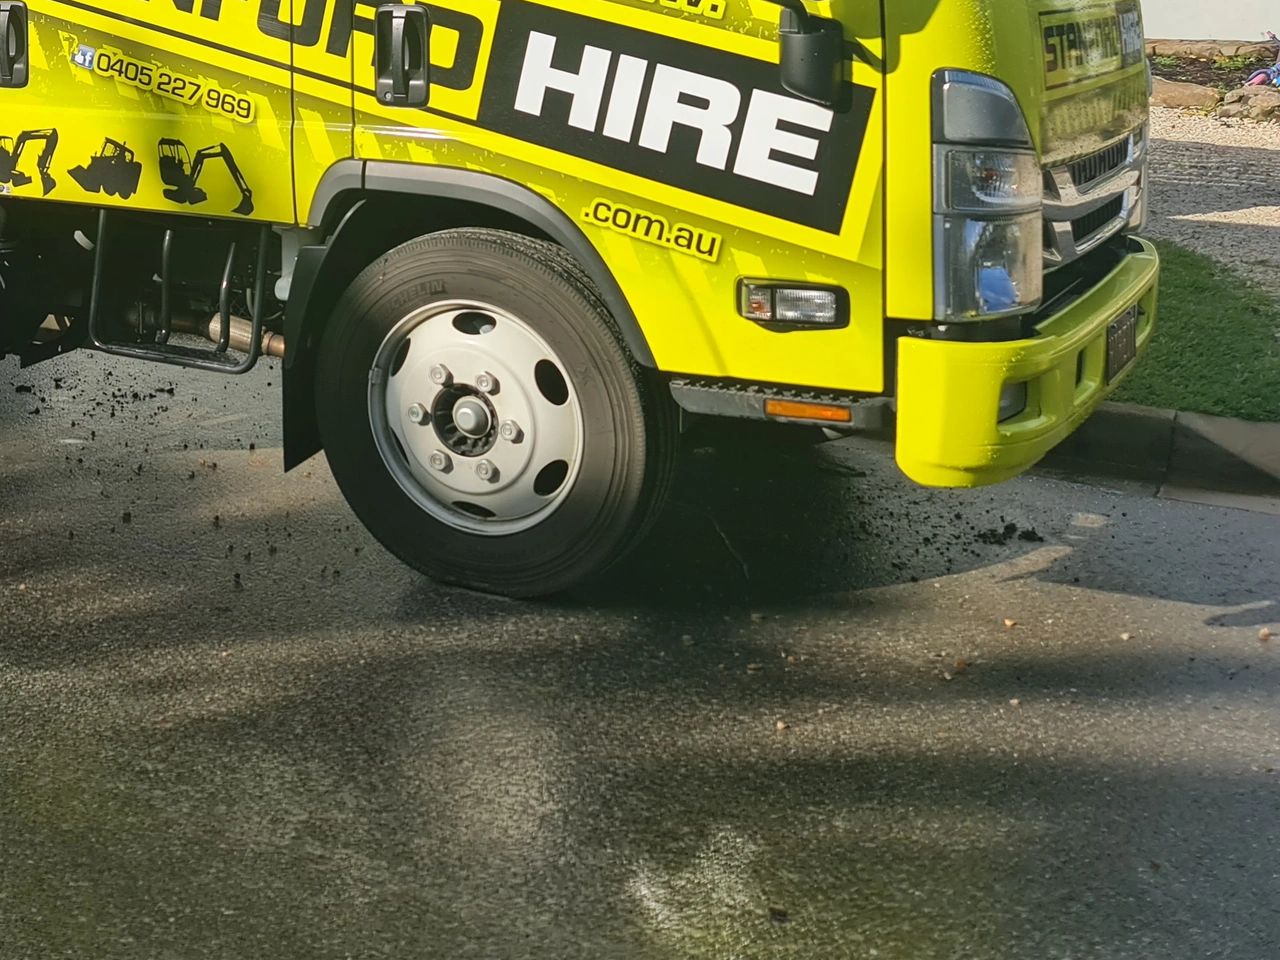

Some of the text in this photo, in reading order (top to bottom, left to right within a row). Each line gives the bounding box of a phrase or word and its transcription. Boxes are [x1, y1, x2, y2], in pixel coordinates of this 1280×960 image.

[97, 53, 252, 119] 0405 227 969
[514, 30, 834, 197] HIRE
[583, 200, 717, 257] .com.au
